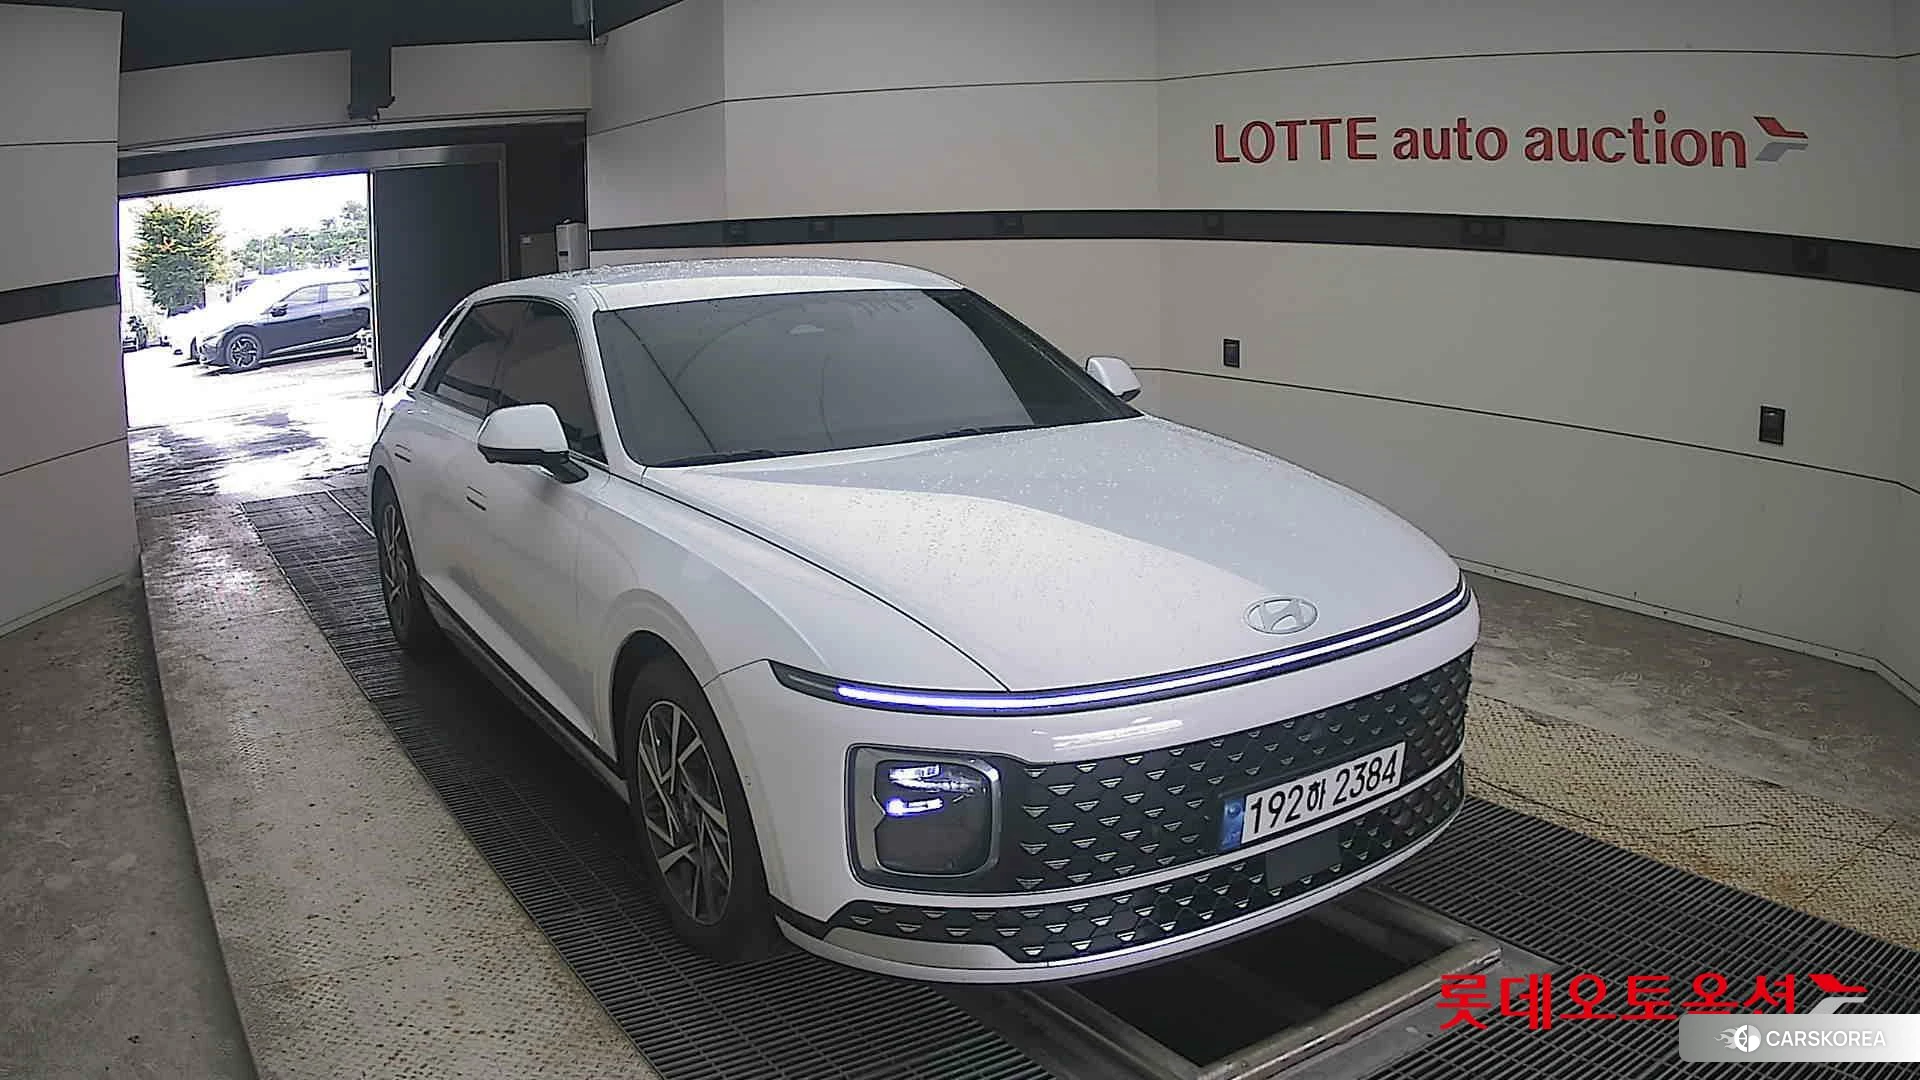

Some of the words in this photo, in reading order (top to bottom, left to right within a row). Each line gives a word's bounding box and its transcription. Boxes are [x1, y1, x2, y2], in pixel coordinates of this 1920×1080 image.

[1214, 116, 1377, 164] LOTTE
[1392, 117, 1508, 161] auto
[1523, 109, 1747, 168] auction
[1251, 778, 1326, 834] 192하
[1333, 749, 1398, 806] 2384
